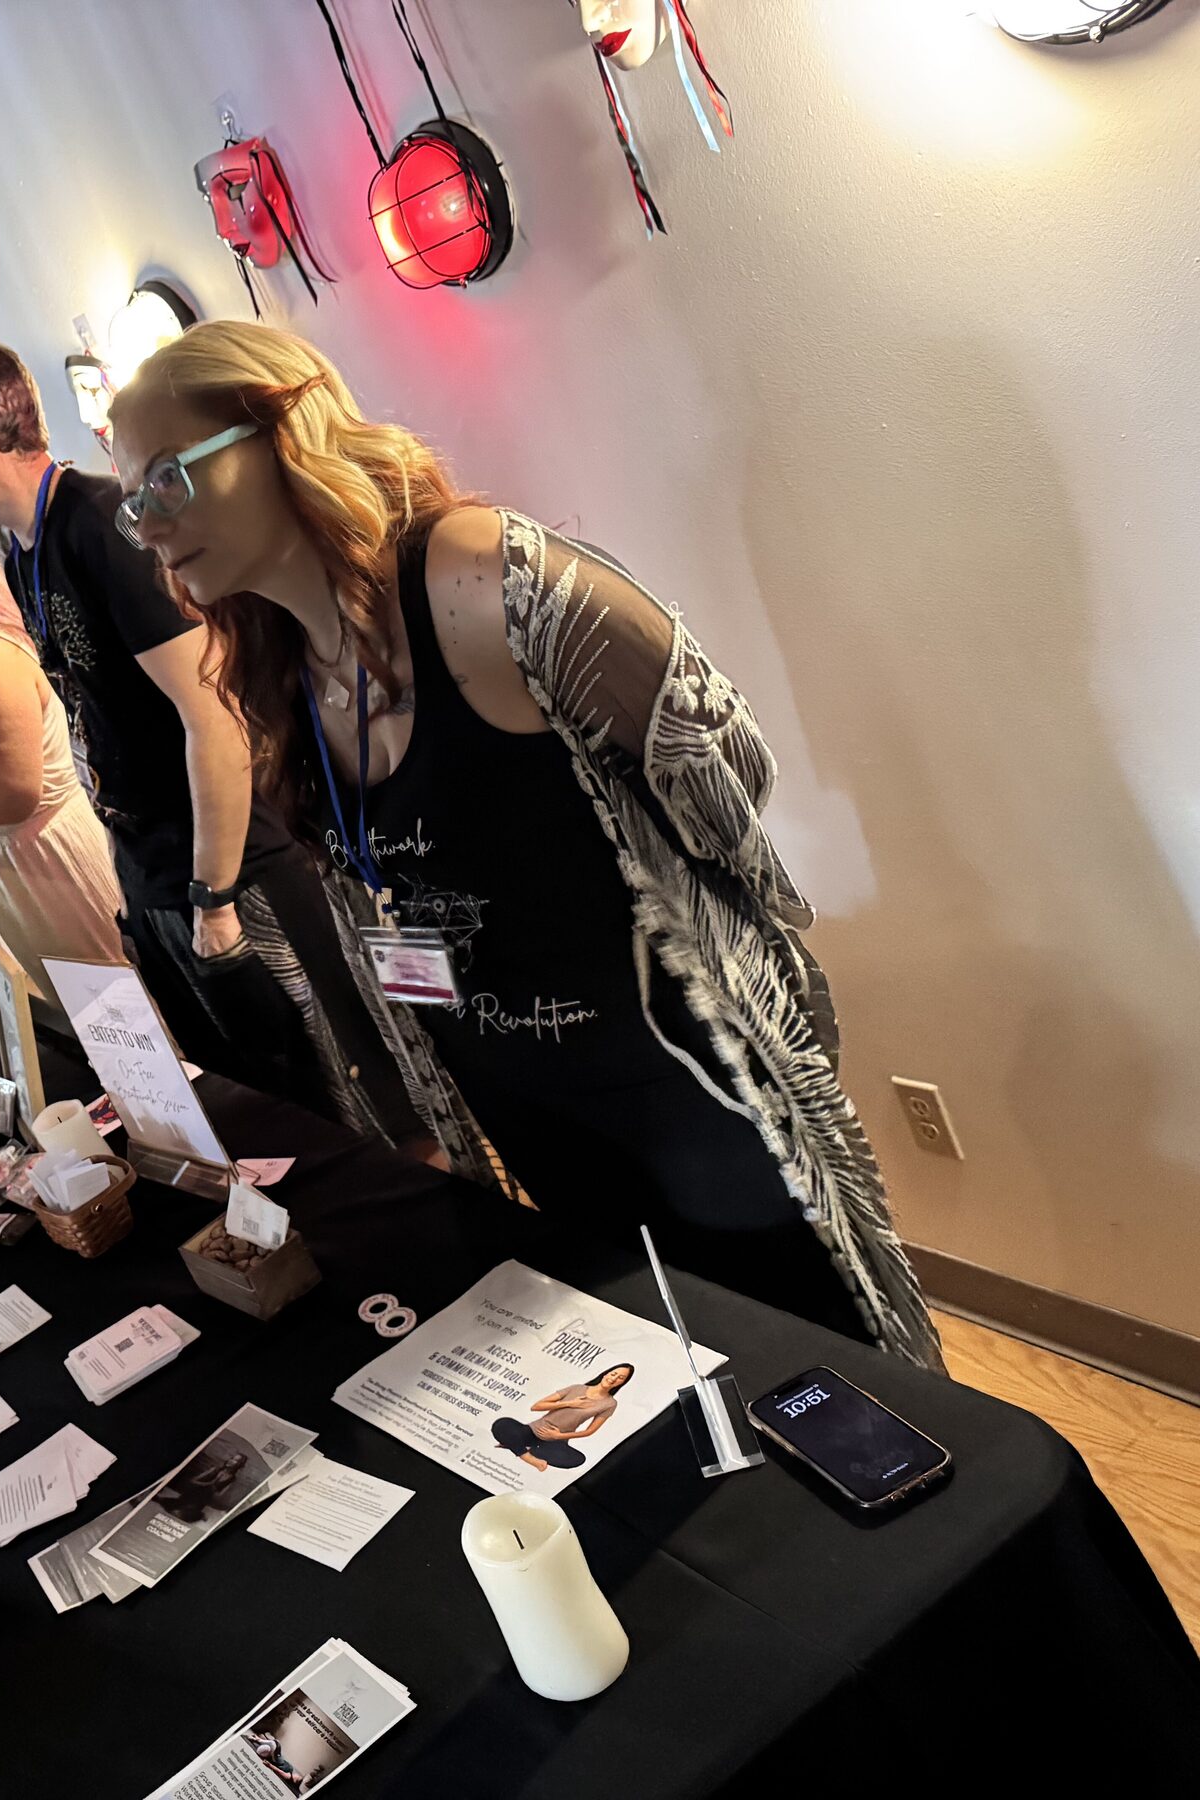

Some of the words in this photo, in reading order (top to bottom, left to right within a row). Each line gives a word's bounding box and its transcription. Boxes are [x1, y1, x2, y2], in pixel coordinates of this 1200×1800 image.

[87, 1024, 119, 1046] ENTER
[116, 1028, 135, 1048] TO
[131, 1033, 157, 1052] WIN
[480, 1298, 497, 1311] You
[496, 1307, 513, 1317] are
[513, 1314, 547, 1330] invited
[482, 1319, 502, 1330] join
[502, 1325, 518, 1336] the
[486, 1344, 521, 1364] ACCESS
[546, 1332, 606, 1363] PHOENIX
[428, 1352, 439, 1361] &
[436, 1355, 484, 1382] COMMUNITY
[484, 1378, 526, 1402] SUPPORT
[451, 1346, 467, 1356] ON
[464, 1352, 501, 1373] DEMAND
[500, 1367, 529, 1386] TOOLS
[417, 1381, 433, 1391] CALM
[431, 1387, 441, 1395] THE
[438, 1391, 458, 1405] STRESS
[455, 1401, 482, 1416] RESPONSE
[441, 1377, 461, 1391] STRESS
[462, 1388, 488, 1405] IMPROVED
[485, 1400, 502, 1412] MOOD
[783, 1388, 831, 1419] 10:51
